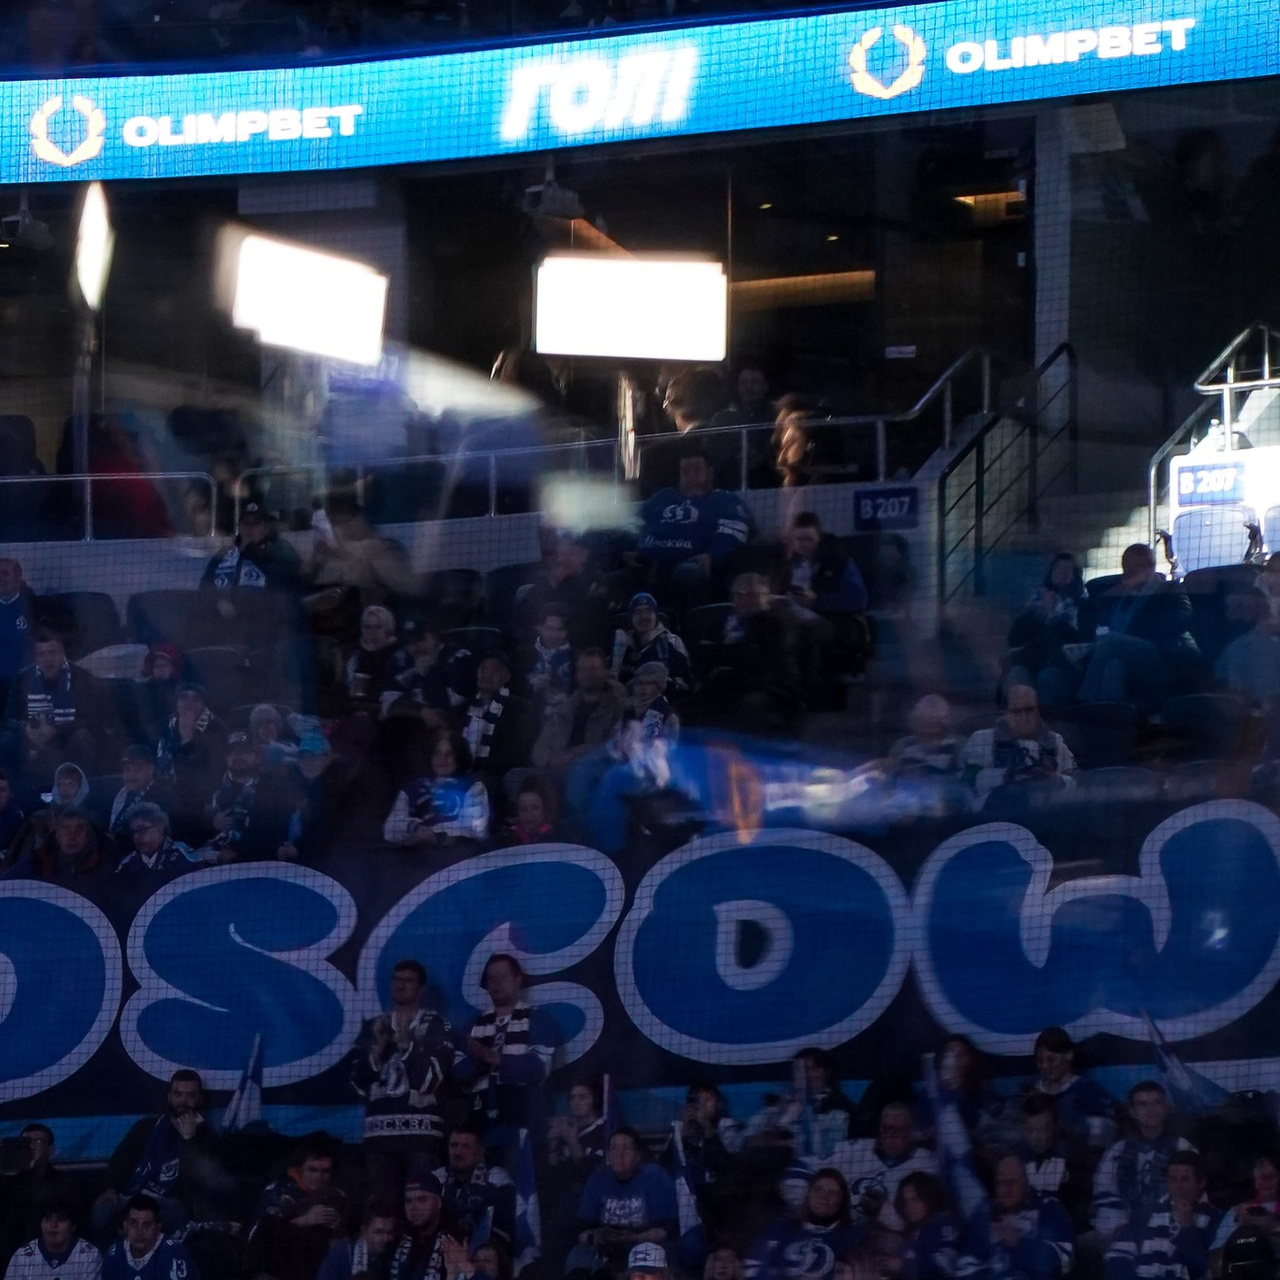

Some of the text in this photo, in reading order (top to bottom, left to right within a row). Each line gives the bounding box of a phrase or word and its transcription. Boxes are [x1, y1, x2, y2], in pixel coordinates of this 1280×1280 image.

[946, 18, 1196, 74] OLIMPBET
[123, 105, 363, 147] OLIMPBET
[1196, 467, 1237, 494] 207
[876, 496, 911, 518] 207
